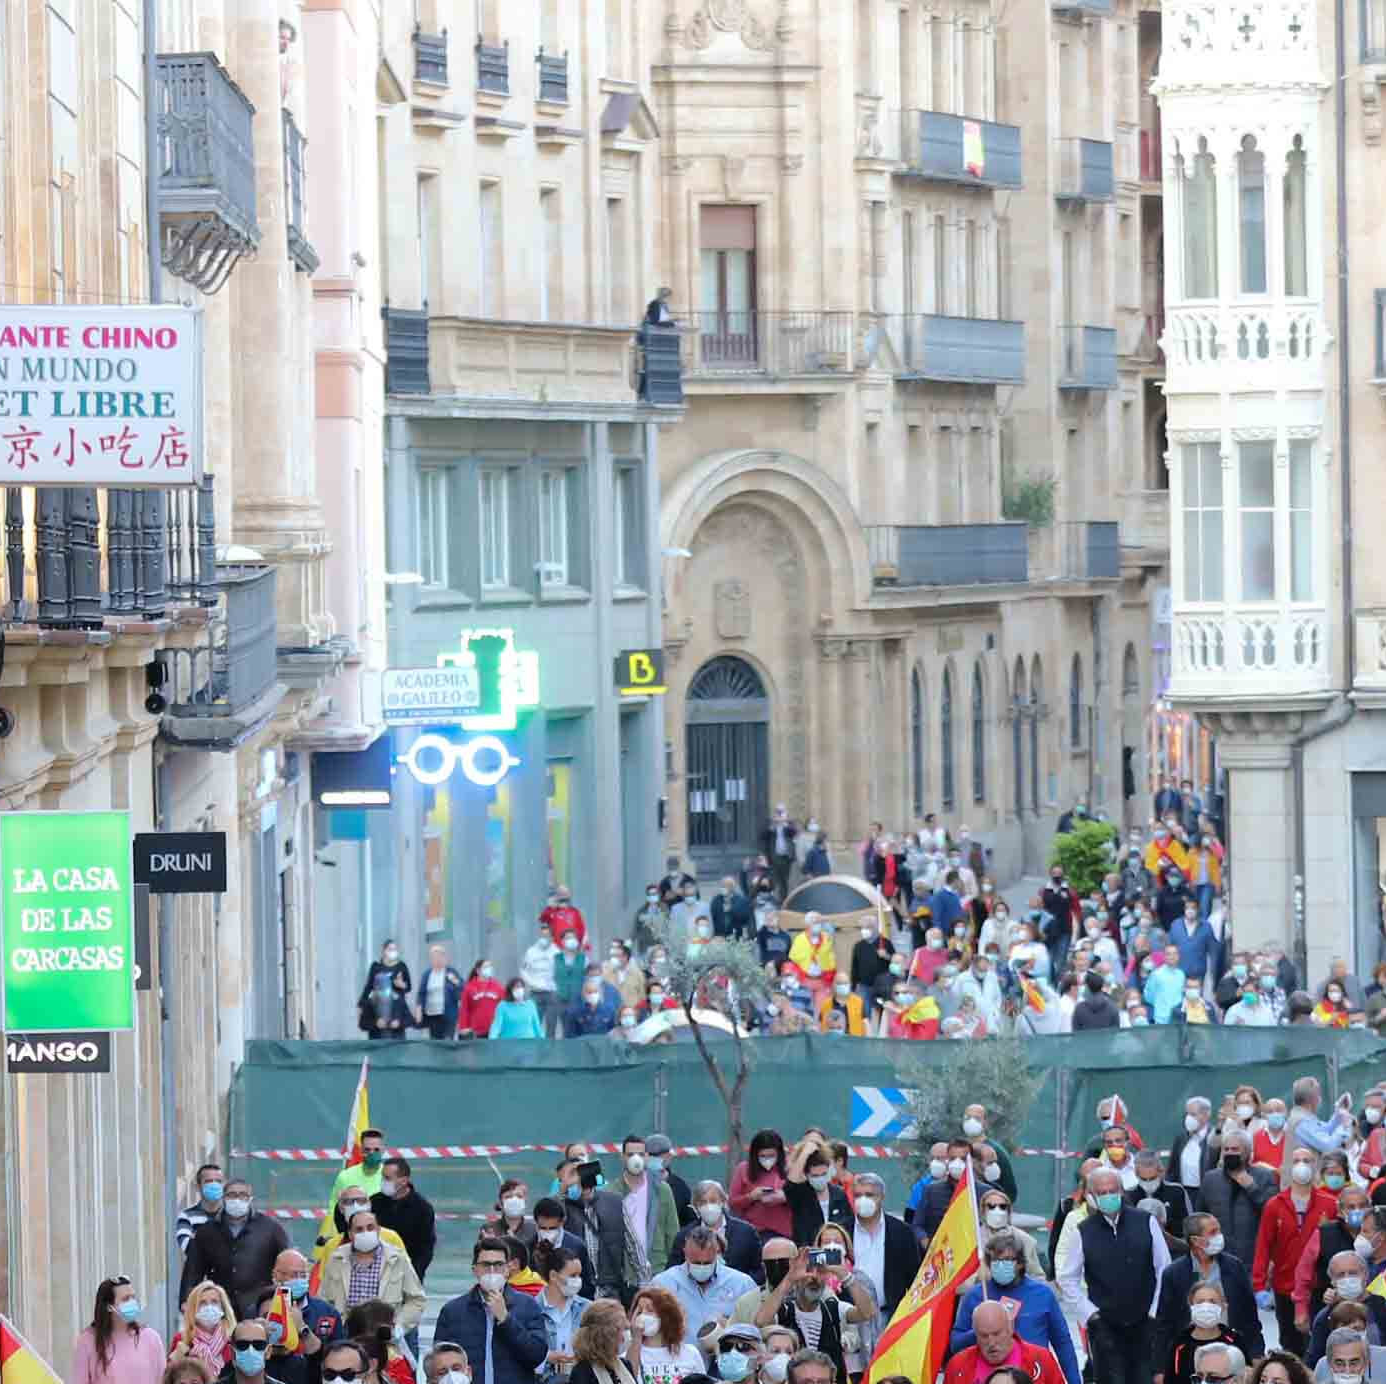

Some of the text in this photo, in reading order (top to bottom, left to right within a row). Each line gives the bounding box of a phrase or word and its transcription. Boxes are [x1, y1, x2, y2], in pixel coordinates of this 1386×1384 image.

[82, 327, 178, 349] CHINO
[21, 357, 138, 382] MUNDO
[50, 391, 175, 417] LIBRE
[395, 673, 470, 688] ACADEMIA
[628, 653, 656, 684] B
[150, 853, 212, 872] DRUNI
[12, 866, 120, 893] LA CASA
[20, 907, 113, 932] DE LAS
[11, 945, 124, 973] CARCASAS
